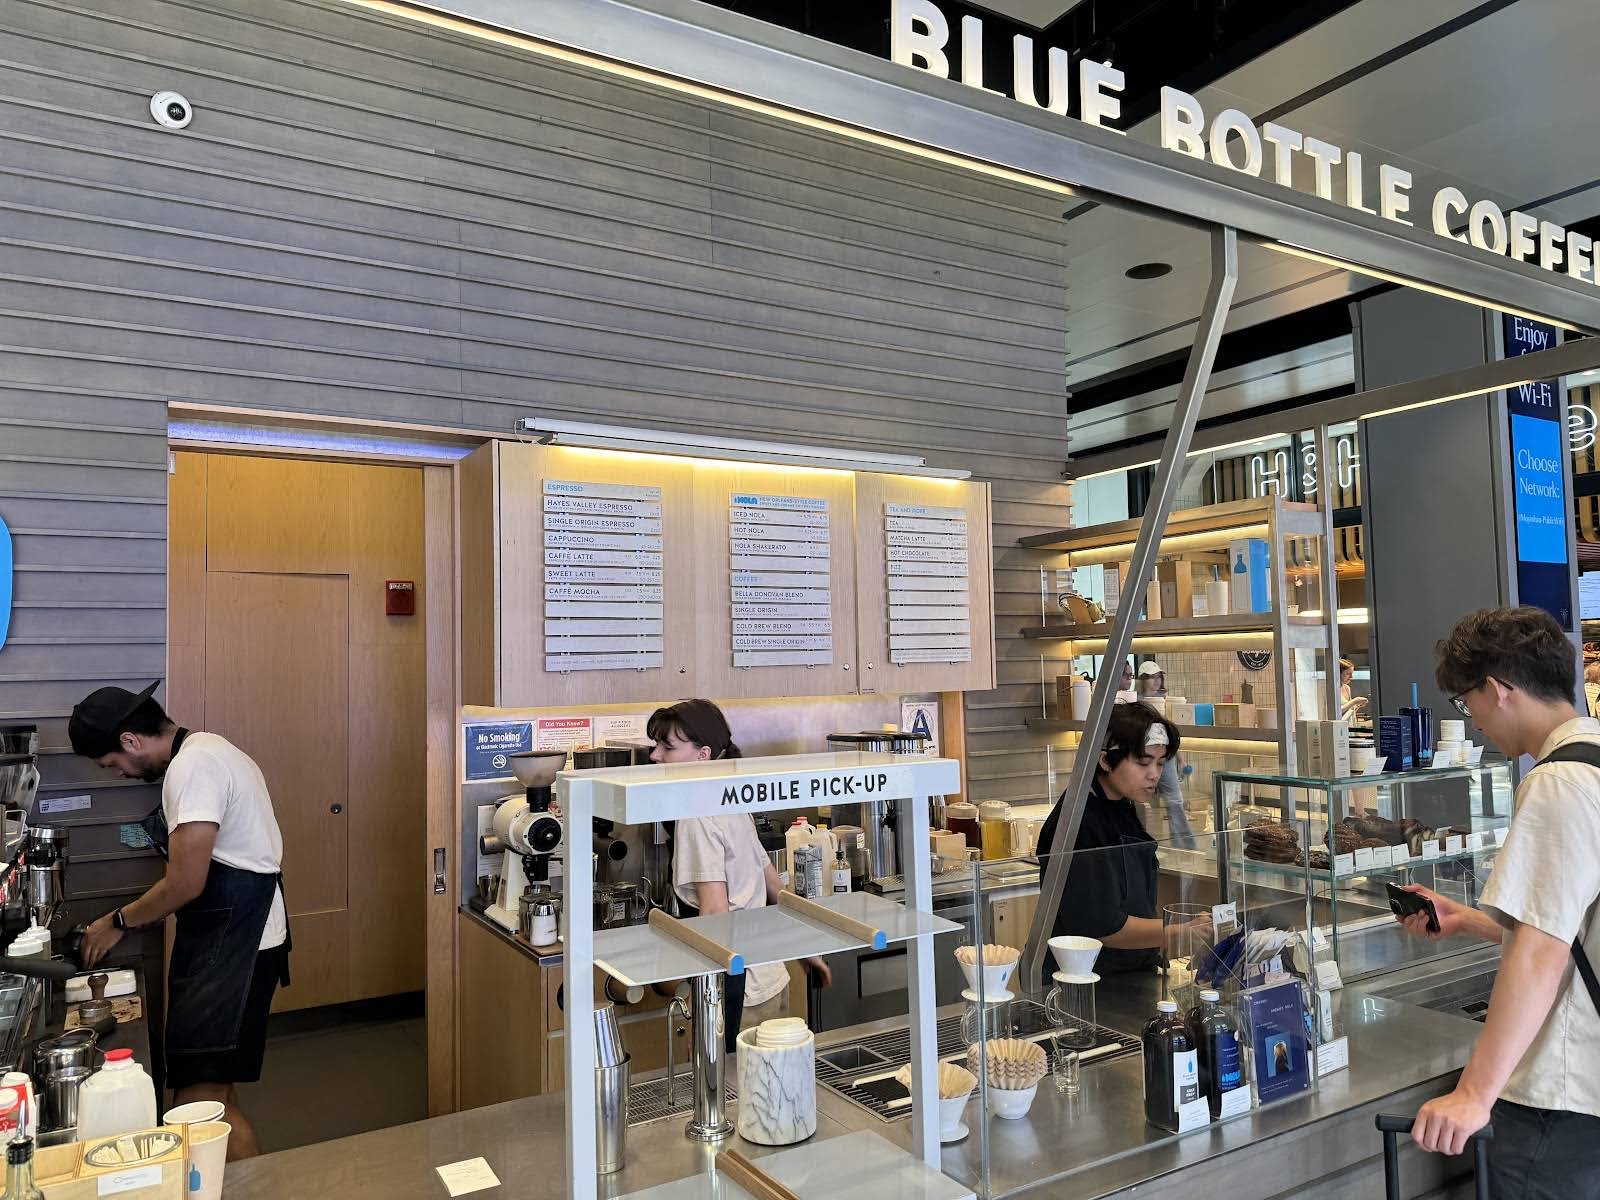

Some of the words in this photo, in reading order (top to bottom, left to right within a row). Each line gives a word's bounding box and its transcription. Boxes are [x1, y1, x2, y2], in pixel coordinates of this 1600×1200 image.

[892, 0, 1127, 137] BLUE
[1161, 86, 1414, 228] BOTTLE
[1433, 187, 1600, 286] COFFE
[1513, 317, 1549, 350] Enjoy
[1518, 381, 1552, 408] Wi-Fi
[1518, 448, 1559, 474] Choose
[547, 483, 584, 492] ESPRESSO
[1519, 477, 1560, 499] Network:
[547, 499, 570, 507] HAYES
[572, 501, 597, 509] VALLEY
[599, 503, 633, 511] ESPRESSO
[547, 517, 573, 525] SINGLE
[574, 518, 599, 526] ORIGIN
[601, 520, 635, 528] ESPRESSO
[548, 535, 595, 543] CAPPUCCINO
[573, 553, 594, 561] LATTE
[912, 709, 933, 742] A
[478, 733, 489, 744] No
[489, 731, 521, 744] Smoking
[721, 780, 800, 806] MOBILE
[810, 773, 887, 798] PICK-UP
